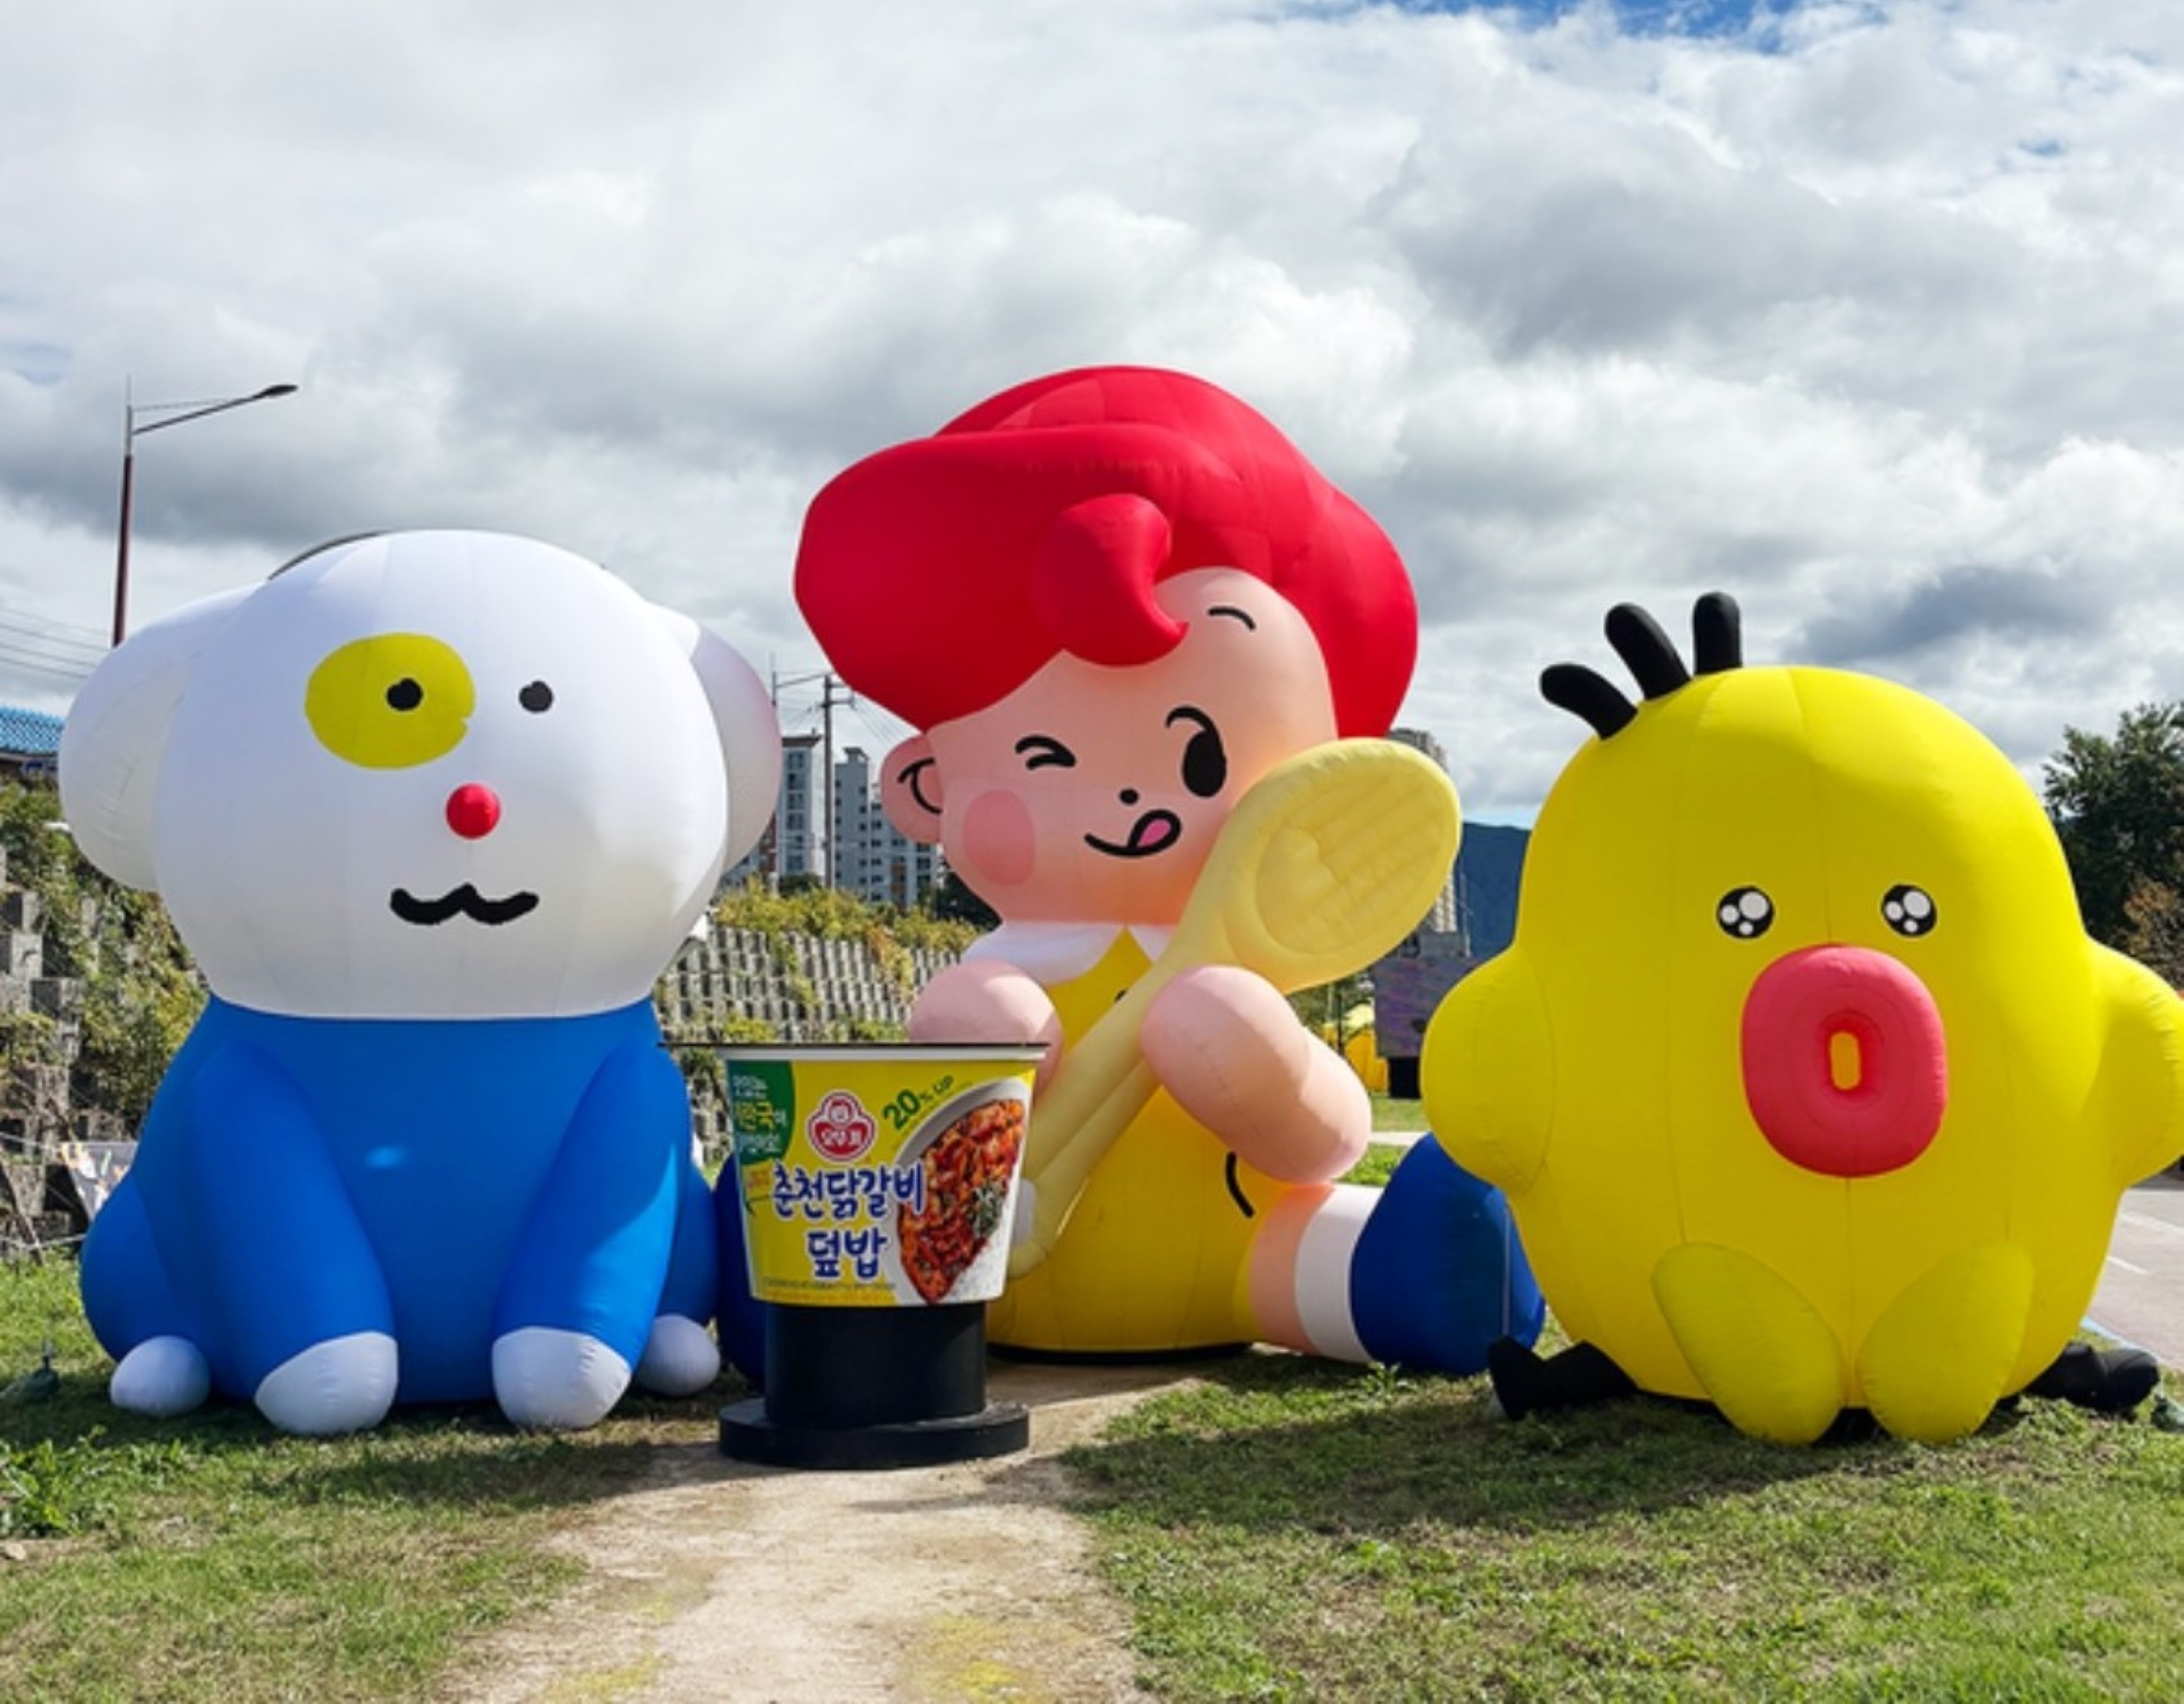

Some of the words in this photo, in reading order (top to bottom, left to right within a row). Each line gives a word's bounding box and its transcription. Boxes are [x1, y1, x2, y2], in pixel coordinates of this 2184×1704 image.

[882, 1087, 933, 1131] 20%
[772, 1161, 923, 1219] 춘천닭갈비
[807, 1227, 887, 1277] 덮밥
